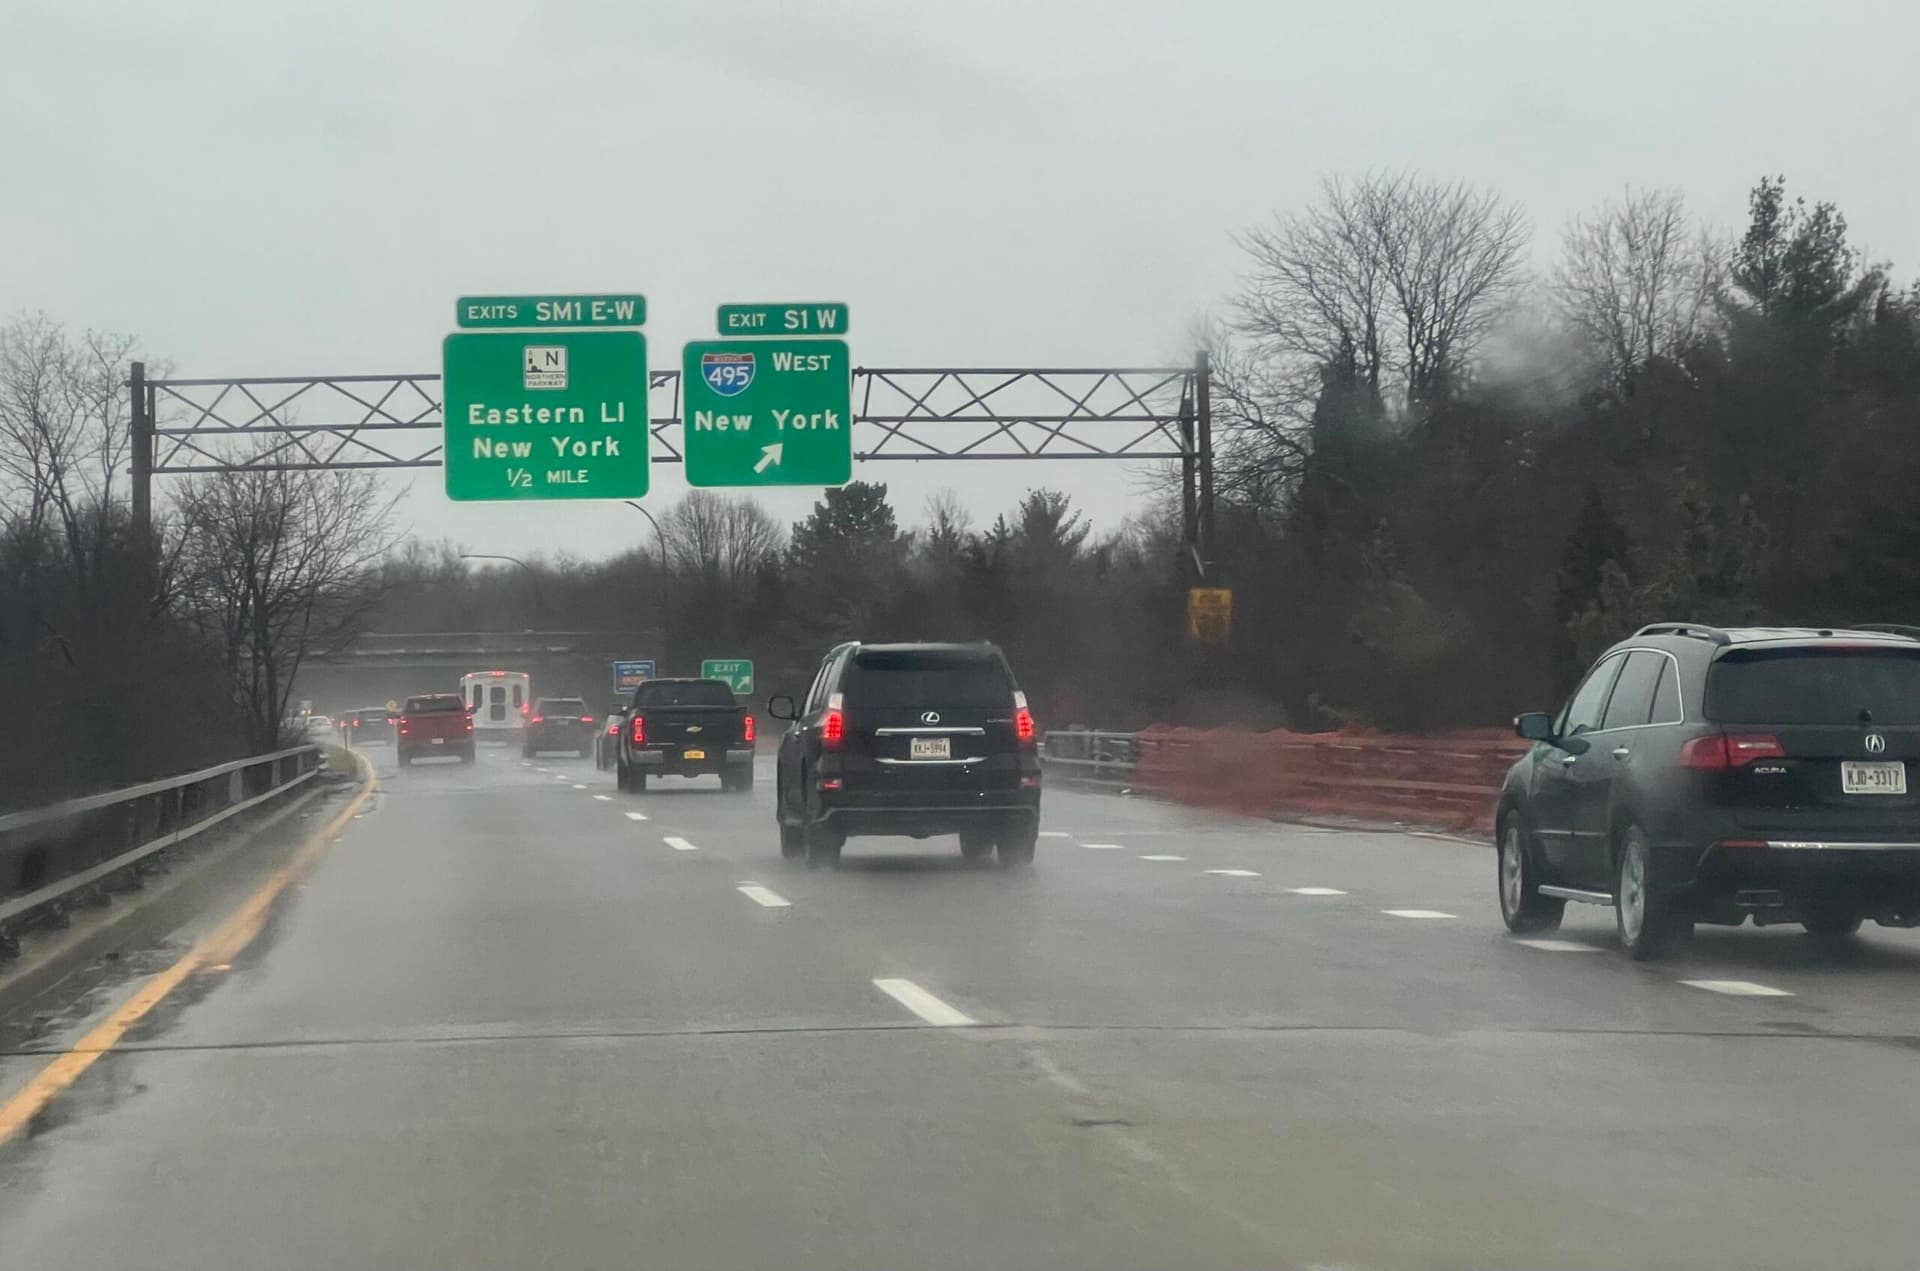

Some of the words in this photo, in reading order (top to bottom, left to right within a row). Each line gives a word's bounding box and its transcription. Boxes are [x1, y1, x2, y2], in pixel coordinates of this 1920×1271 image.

[468, 305, 518, 319] EXITS
[536, 302, 582, 322] SM1
[592, 301, 635, 320] E-W
[728, 313, 767, 327] EXIT
[784, 310, 809, 329] S1
[817, 310, 837, 328] W
[546, 351, 559, 366] N
[772, 352, 831, 371] WEST
[708, 366, 750, 386] 495
[468, 403, 585, 424] Eastern
[601, 402, 625, 422] LI
[696, 411, 752, 431] New
[772, 409, 840, 430] York
[473, 437, 532, 458] New
[551, 436, 621, 457] York
[546, 469, 589, 484] MILE
[713, 663, 740, 672] EXIT
